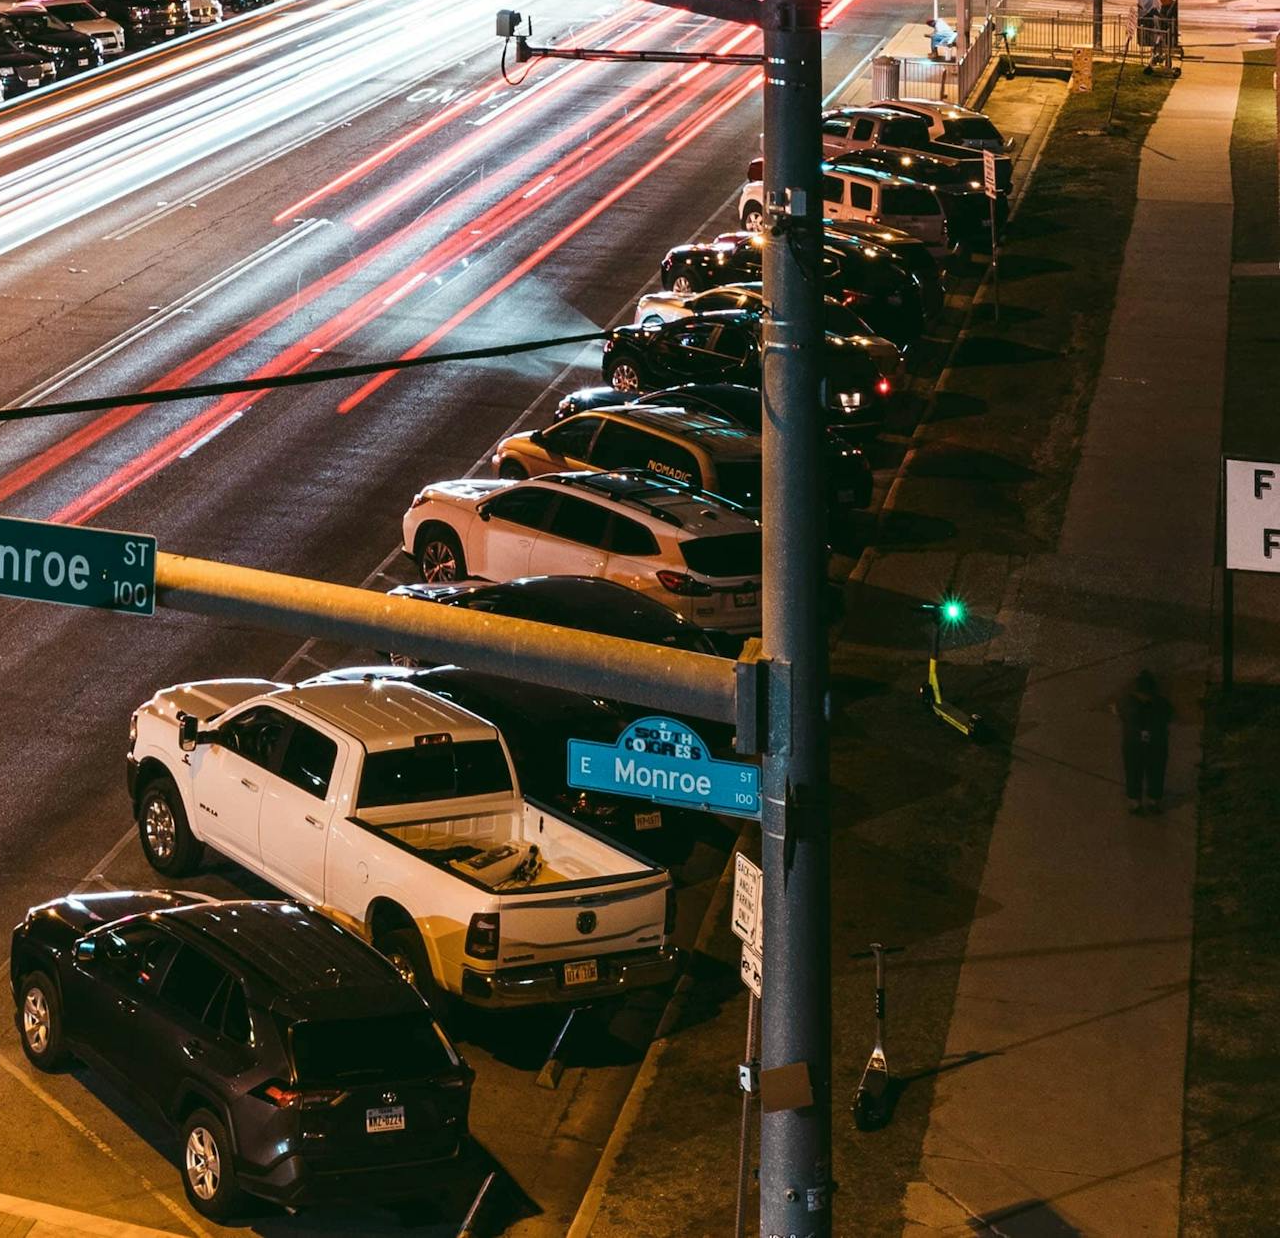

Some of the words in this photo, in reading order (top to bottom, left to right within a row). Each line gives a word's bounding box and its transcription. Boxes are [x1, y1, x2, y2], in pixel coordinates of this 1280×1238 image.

[647, 459, 693, 483] NOMADIC
[123, 541, 149, 566] ST
[113, 580, 147, 607] 100
[634, 727, 692, 744] SOUTH
[625, 737, 702, 760] CONGRESS
[581, 757, 591, 774] E
[614, 757, 711, 795] Monroe
[740, 771, 753, 783] ST
[735, 793, 753, 805] 100
